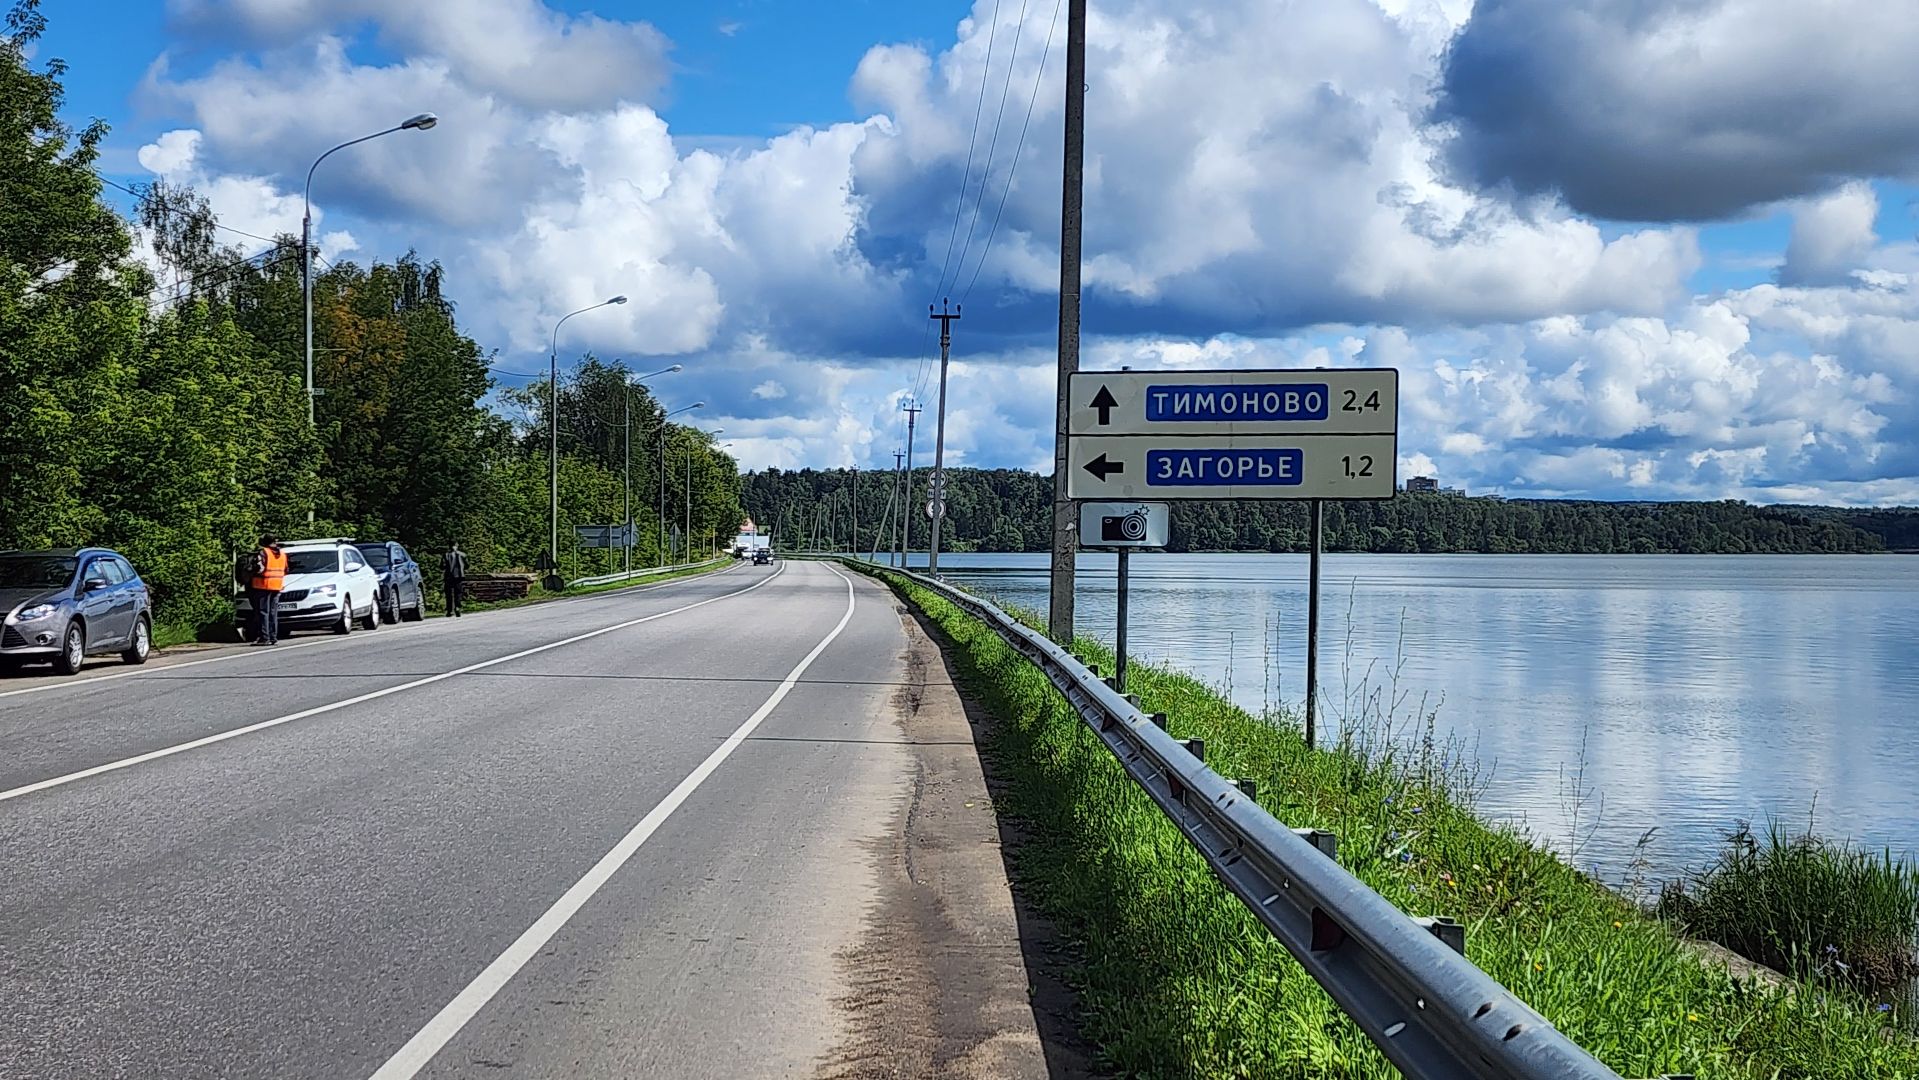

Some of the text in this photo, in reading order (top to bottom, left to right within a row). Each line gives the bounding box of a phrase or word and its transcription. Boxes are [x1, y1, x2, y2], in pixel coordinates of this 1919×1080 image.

[1153, 390, 1380, 414] ТИМОНОВО 2,4
[1157, 455, 1374, 480] ЗАГОРЬЕ 1,2
